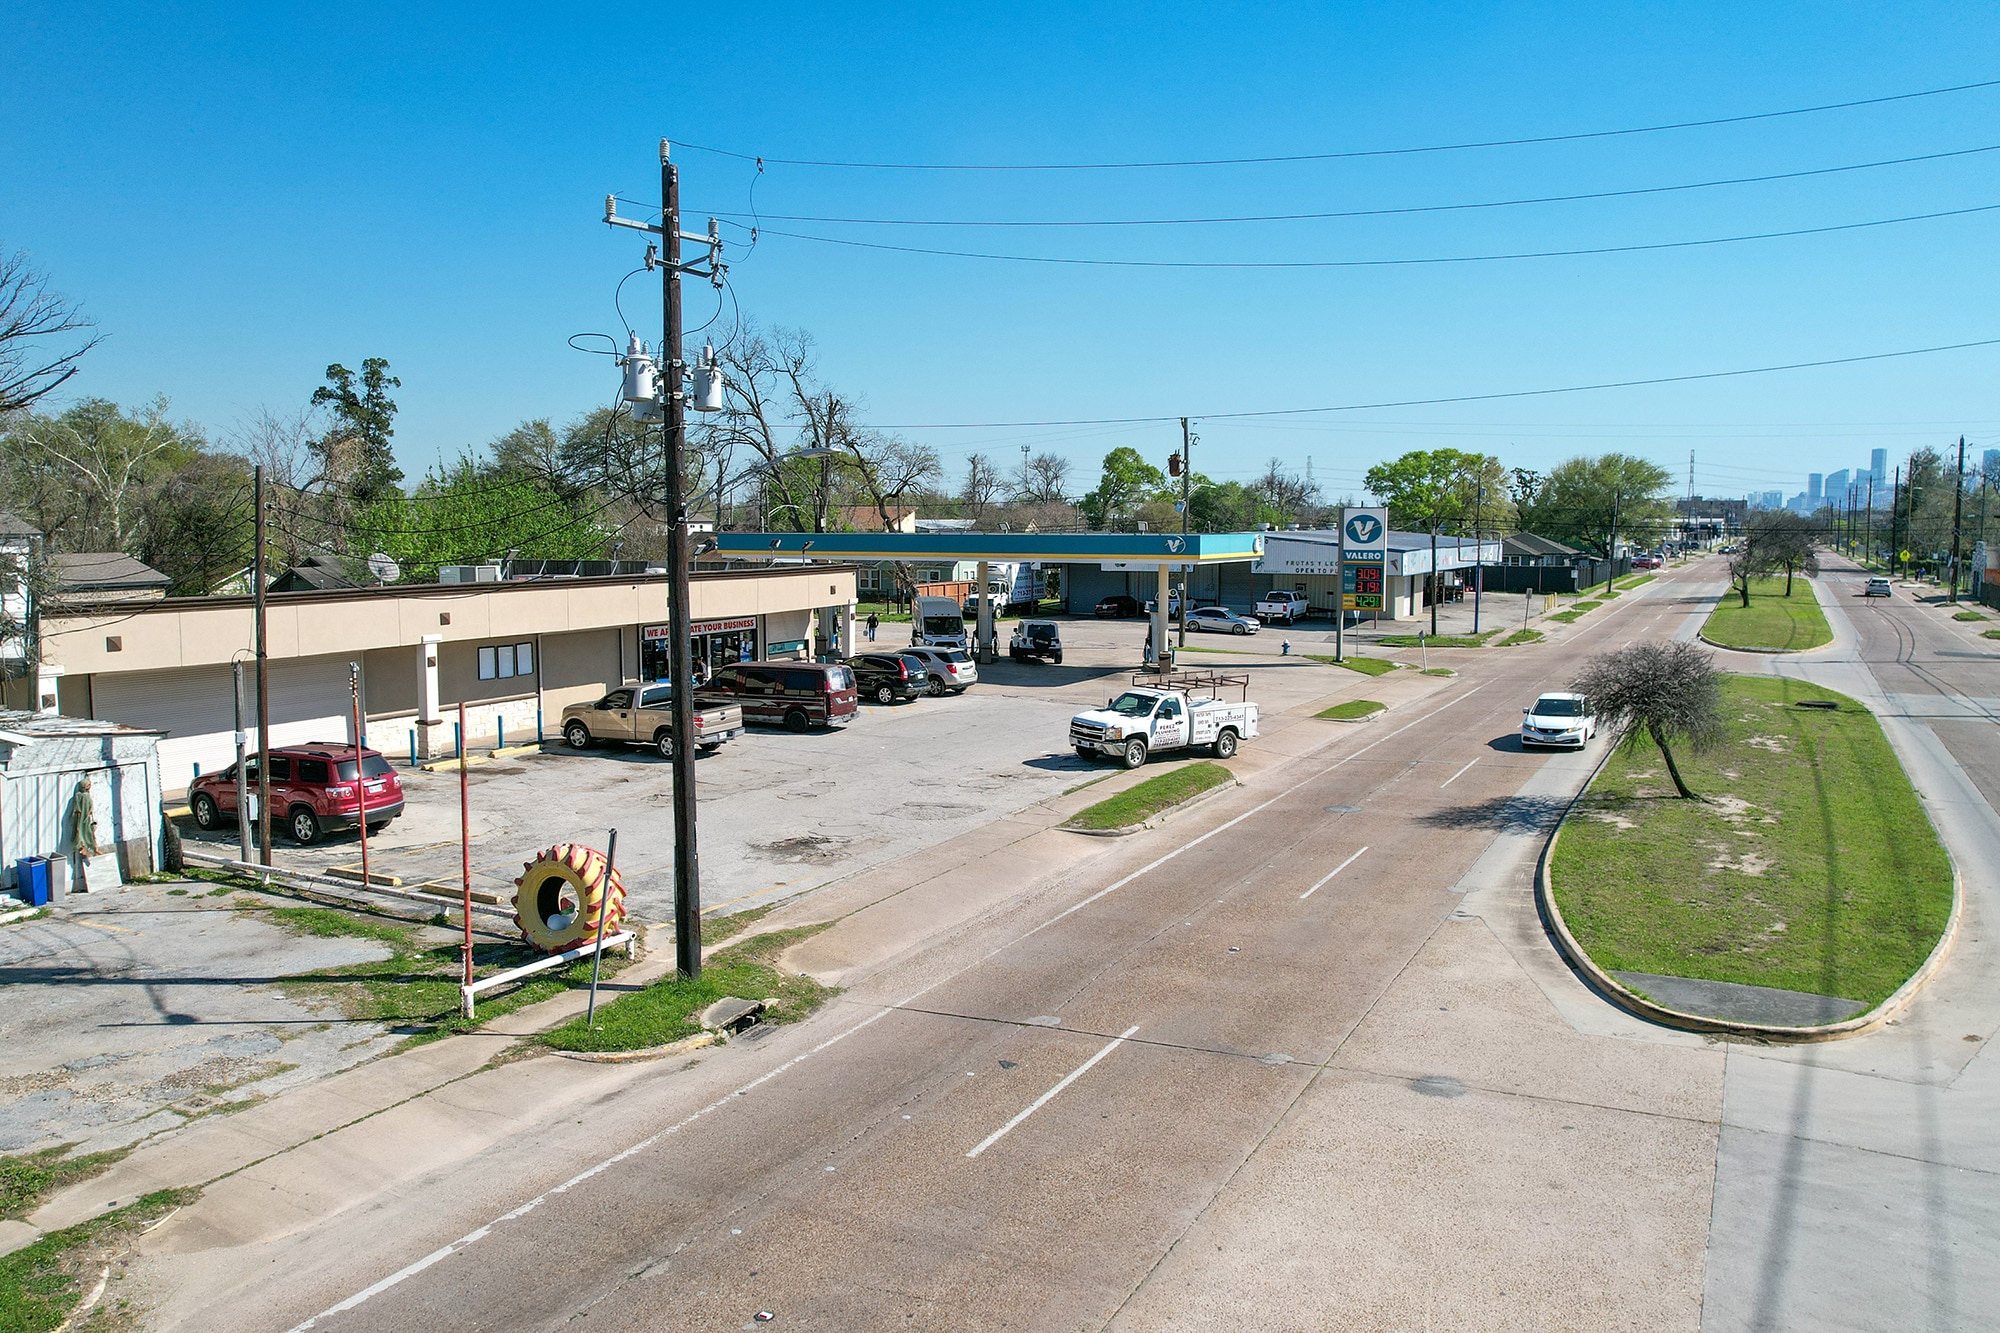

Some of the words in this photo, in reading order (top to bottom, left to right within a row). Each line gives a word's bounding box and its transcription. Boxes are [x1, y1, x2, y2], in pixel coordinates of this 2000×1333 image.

[1345, 552, 1382, 560] VALERO
[647, 629, 659, 637] WE
[704, 622, 722, 632] YOUR
[723, 619, 754, 630] BUSINESS
